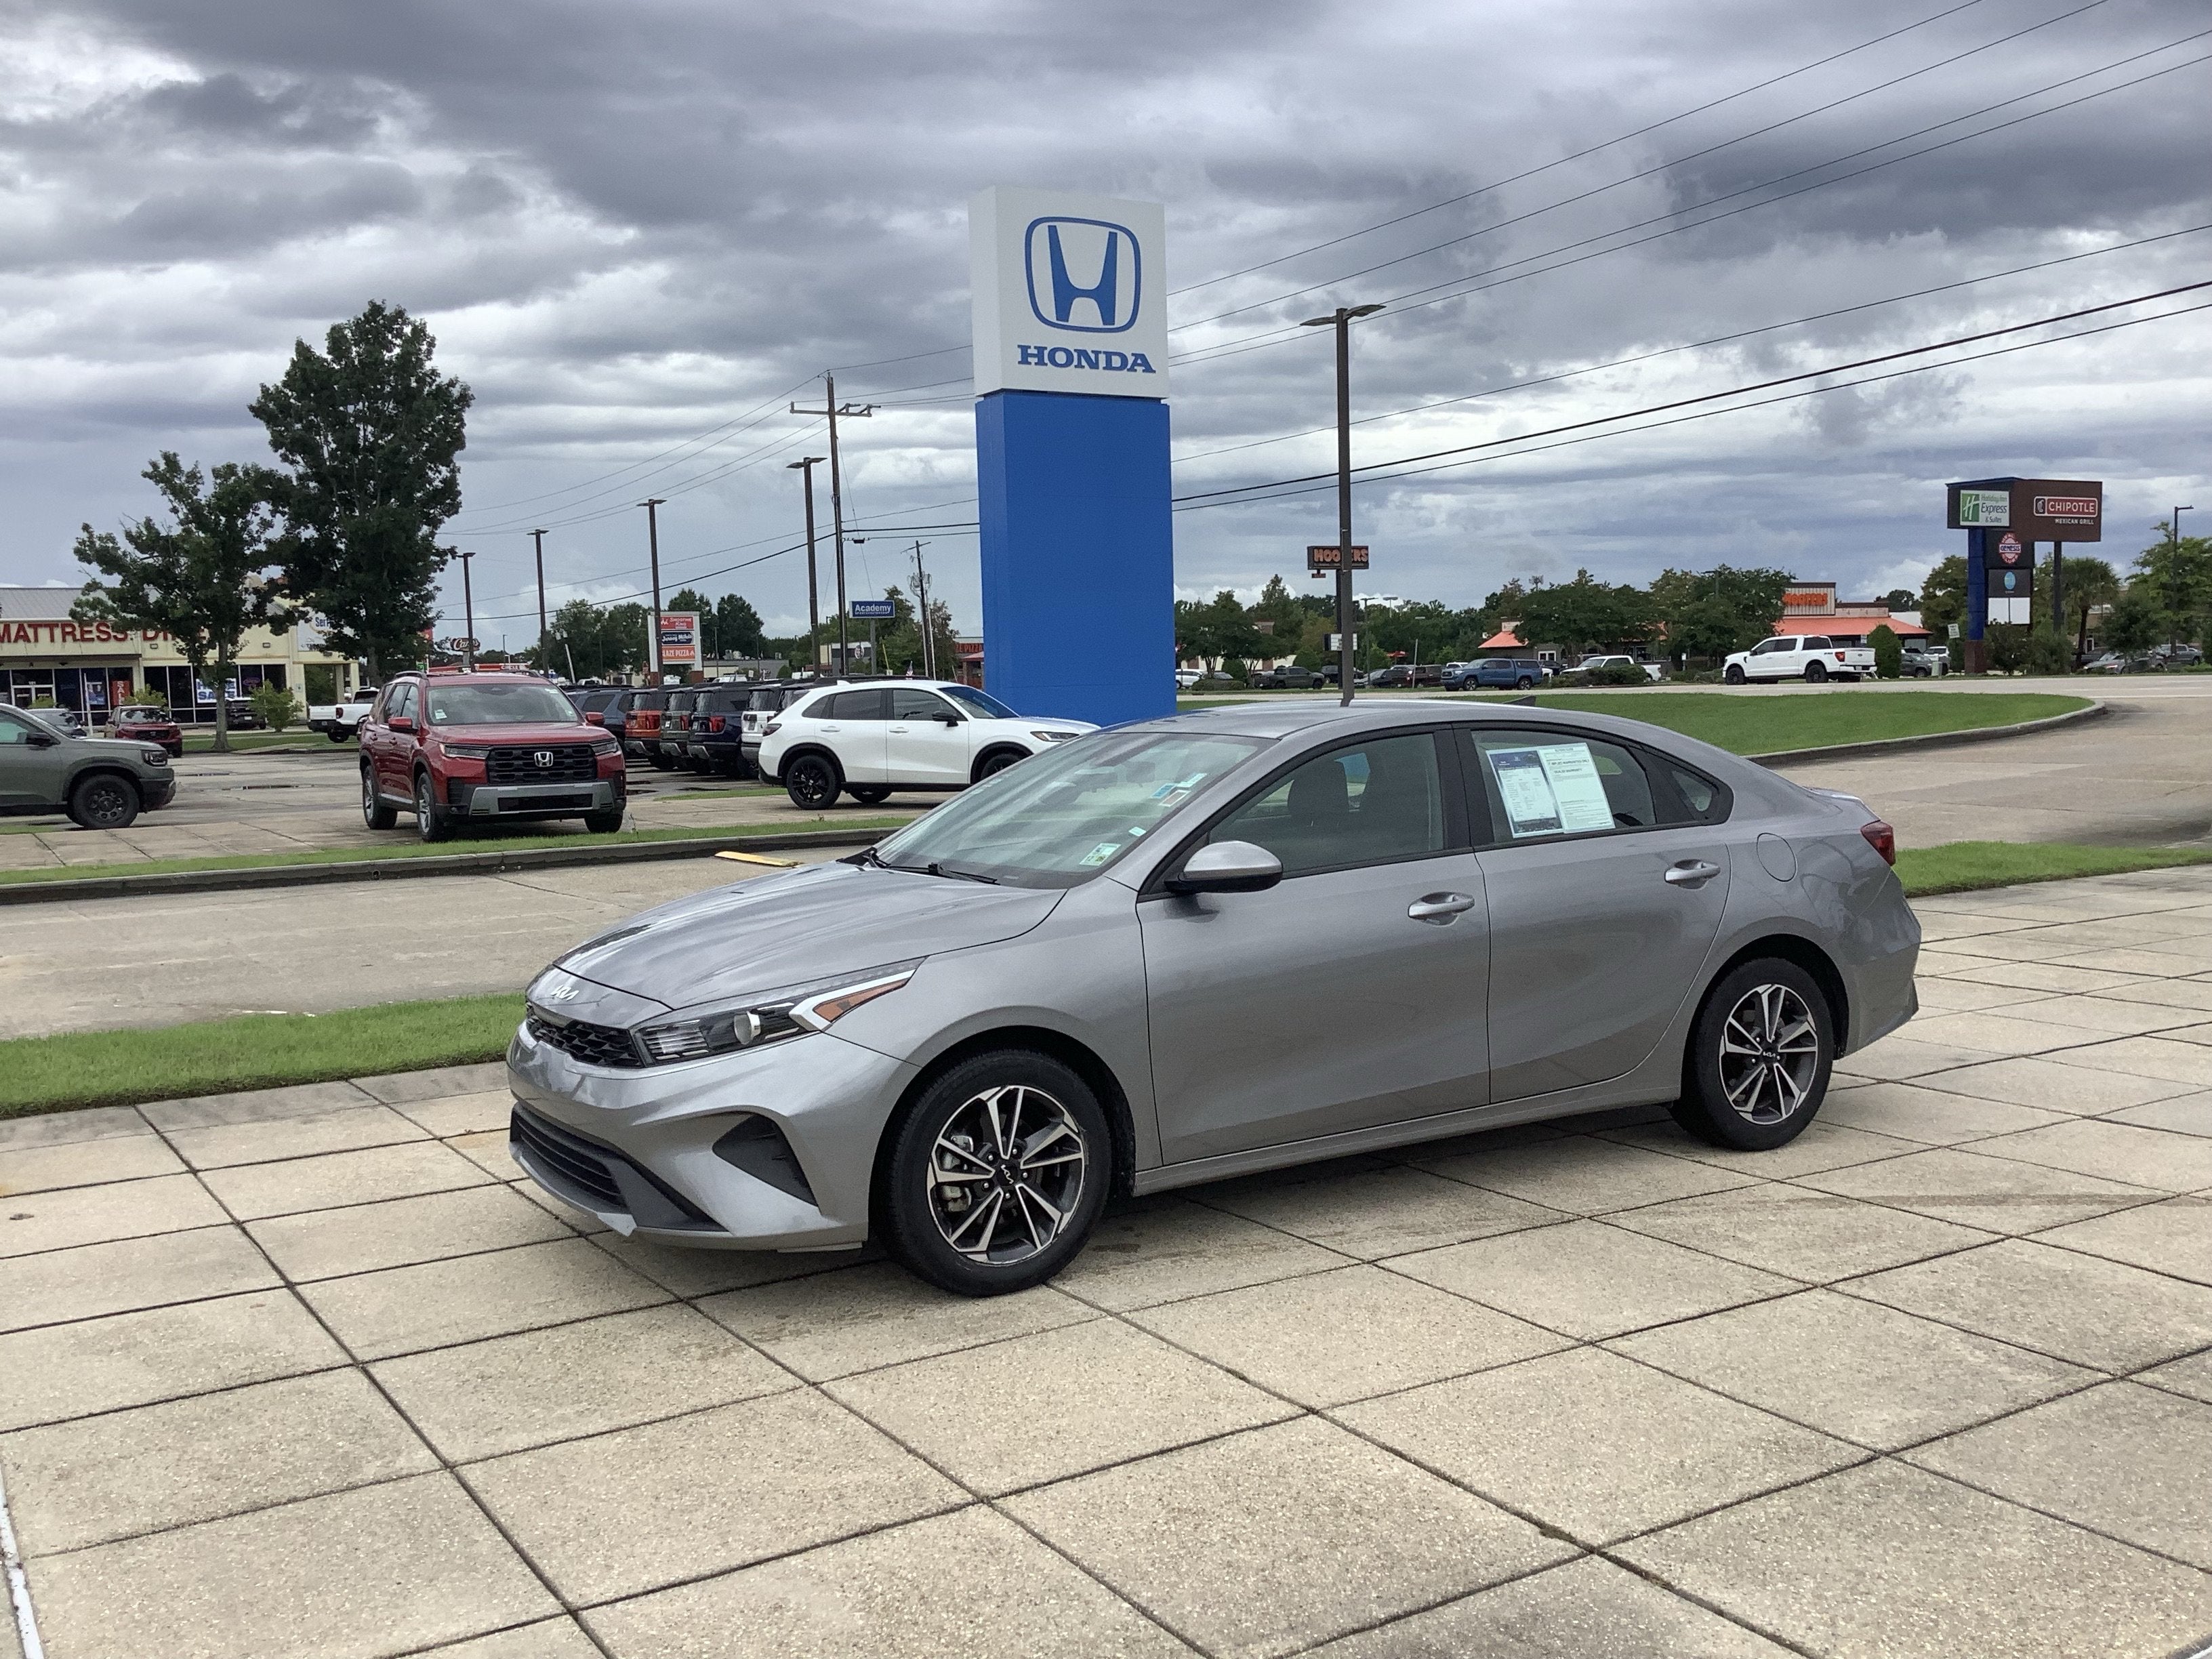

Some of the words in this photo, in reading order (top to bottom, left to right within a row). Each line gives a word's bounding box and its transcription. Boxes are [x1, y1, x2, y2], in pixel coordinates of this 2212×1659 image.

[1017, 344, 1156, 373] HONDA
[1981, 502, 2007, 515] Express
[2048, 501, 2095, 512] CHIPOTLE
[1313, 548, 1368, 562] HOORS
[855, 604, 892, 613] Academy
[198, 691, 235, 700] SAE
